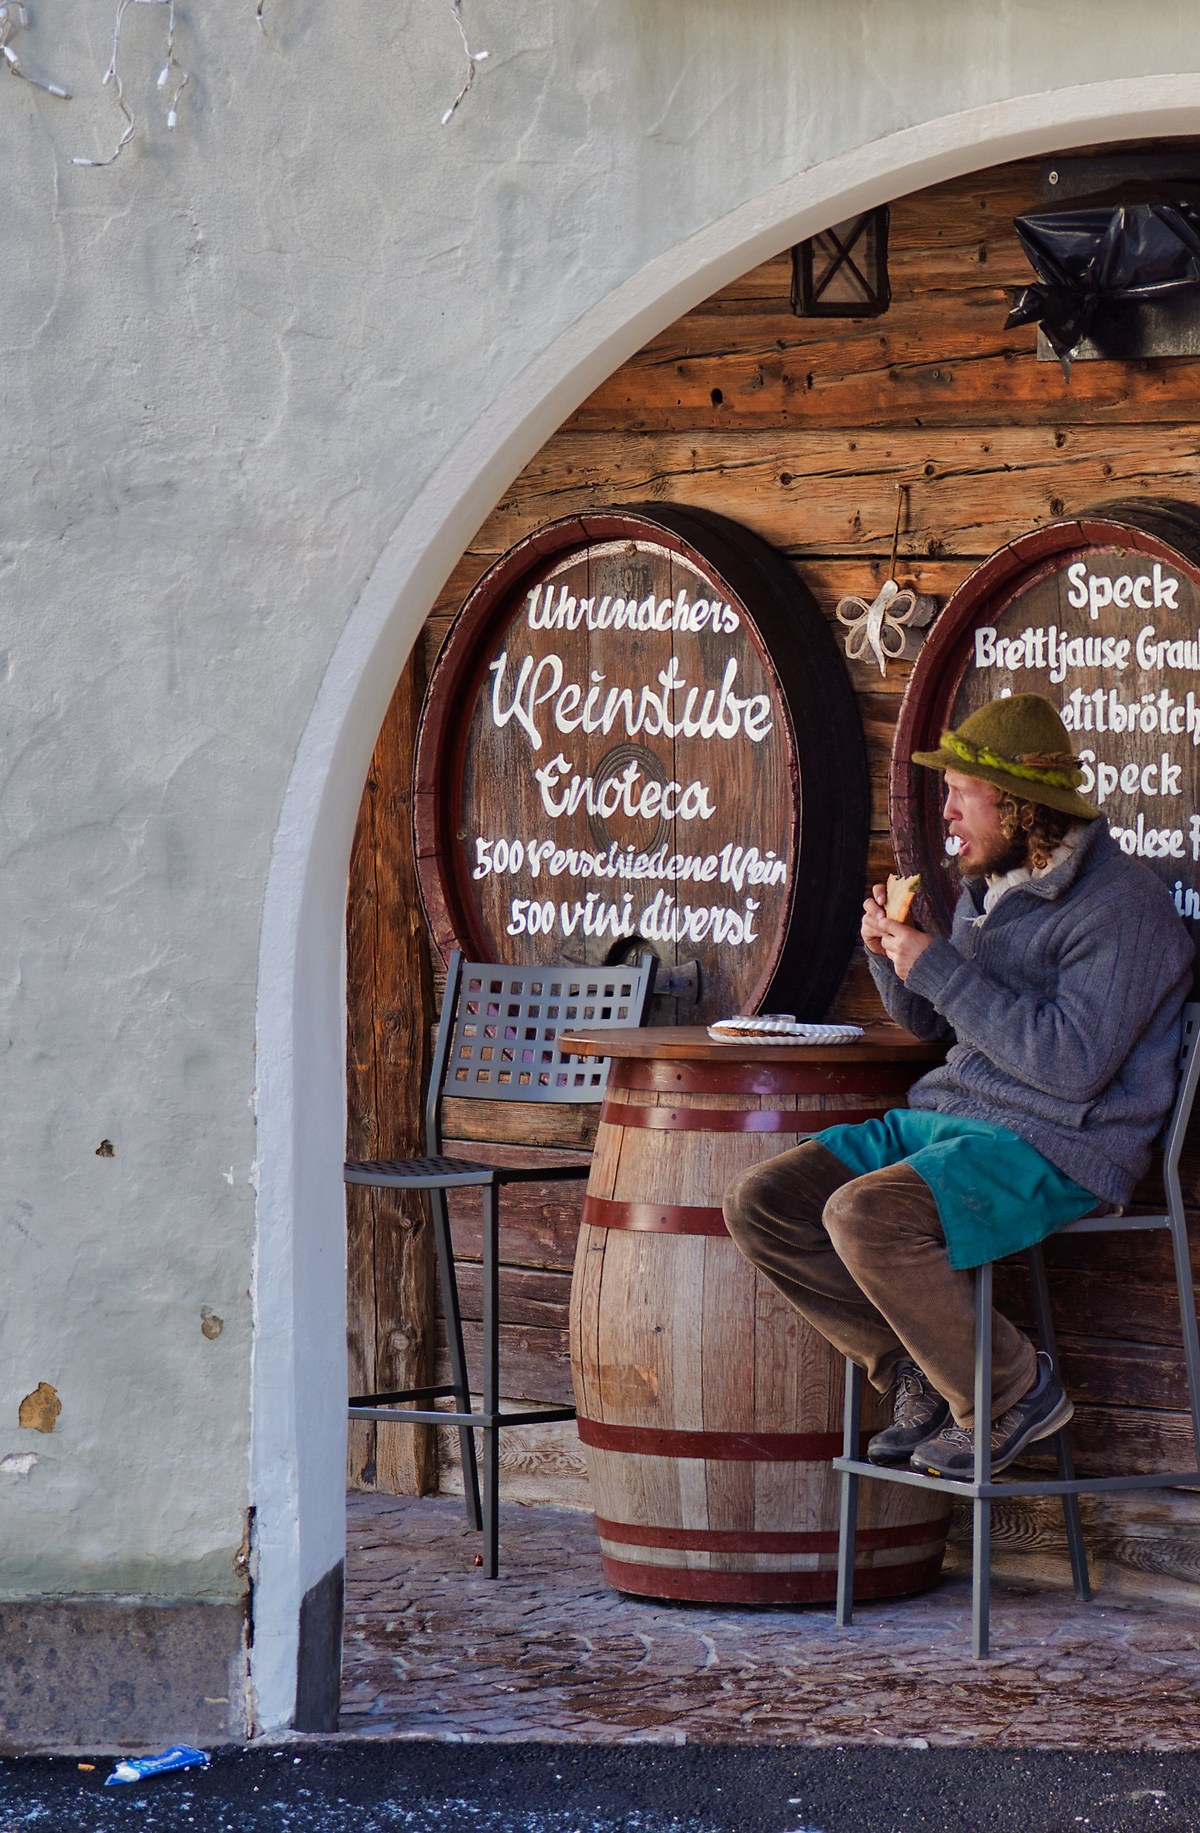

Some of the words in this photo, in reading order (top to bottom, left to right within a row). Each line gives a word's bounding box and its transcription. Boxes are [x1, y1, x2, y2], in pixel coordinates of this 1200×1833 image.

[526, 583, 739, 632] Uhrmachers
[1067, 562, 1179, 619] Speck
[974, 625, 1130, 684] Brettljause
[488, 651, 773, 750] Weinstube
[534, 752, 717, 821] Enoteca
[1077, 749, 1183, 804] Speck
[473, 836, 523, 880] 500
[526, 839, 717, 883] Verschiedene
[506, 898, 555, 936] 500
[561, 892, 635, 938] vini
[639, 888, 761, 946] diversi
